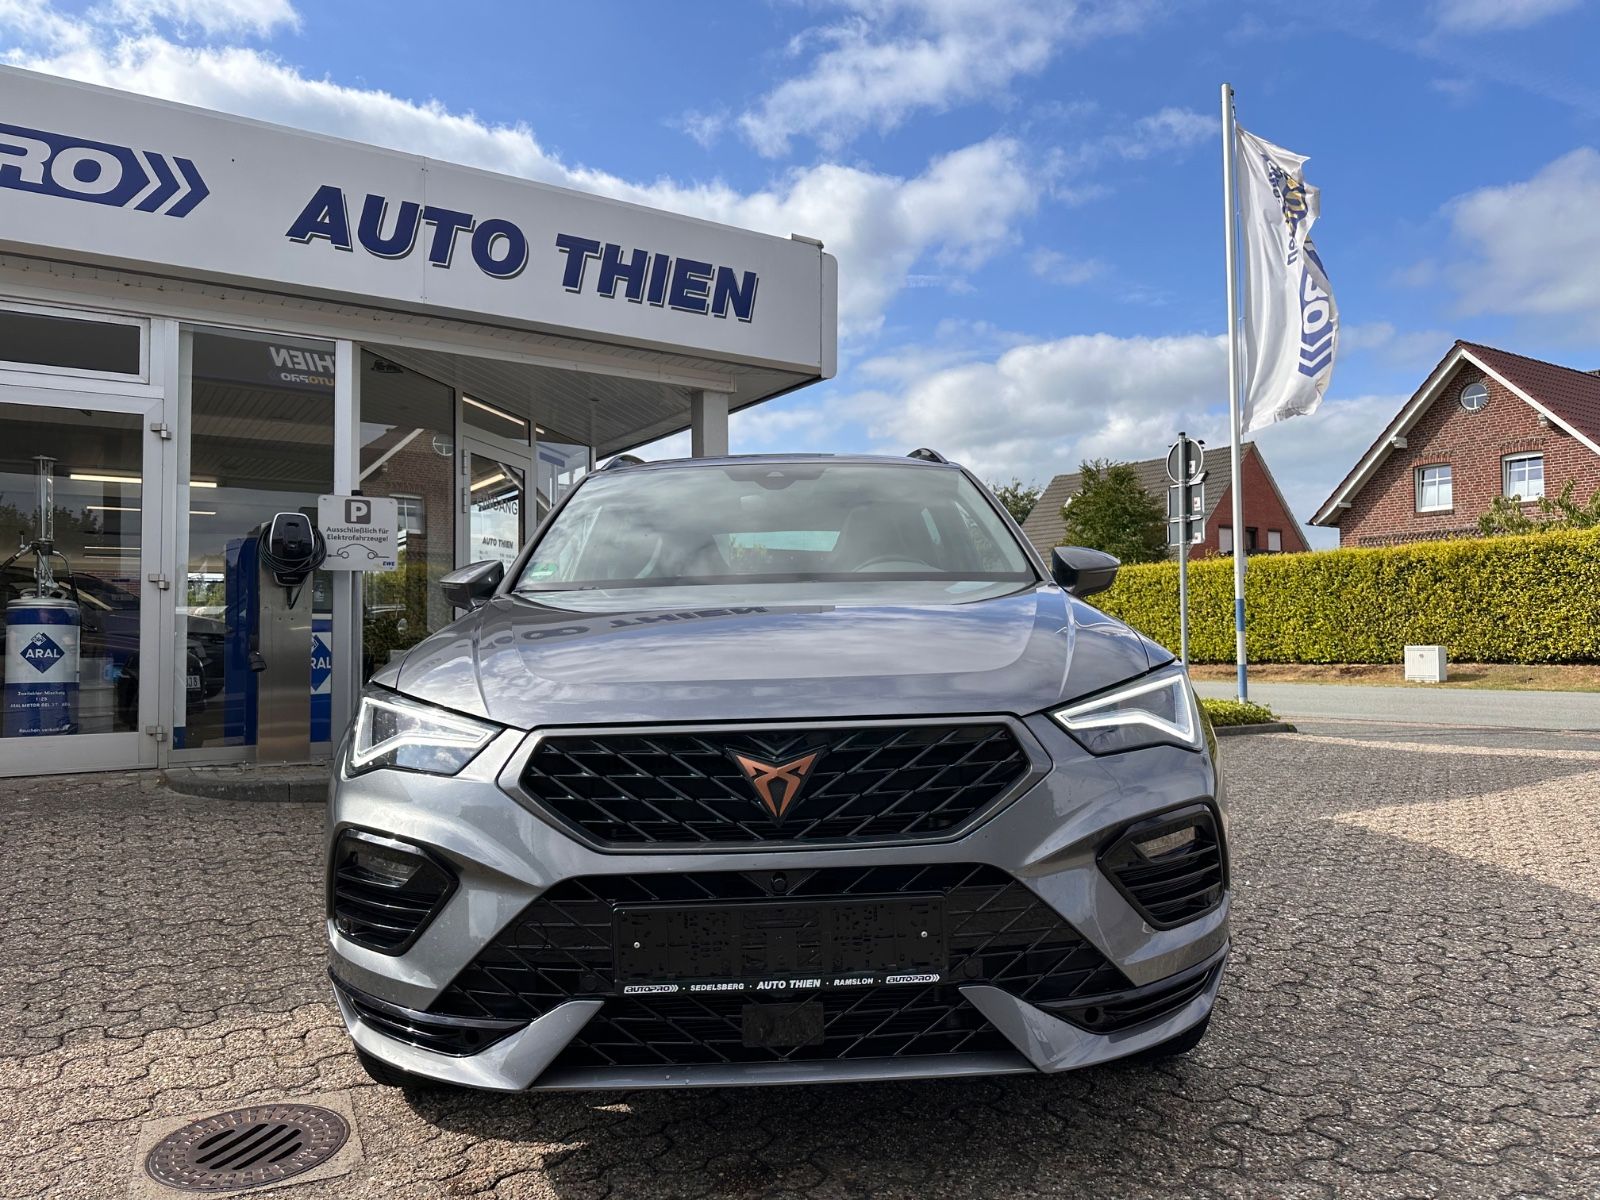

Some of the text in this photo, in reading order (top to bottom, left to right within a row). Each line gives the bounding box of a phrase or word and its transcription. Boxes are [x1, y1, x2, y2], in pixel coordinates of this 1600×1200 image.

[285, 185, 758, 323] AUTO THIEN
[350, 501, 368, 522] P
[326, 526, 389, 535] Ausschließlich für
[482, 536, 514, 549] AUTO THIEN
[25, 648, 60, 658] ARAL
[624, 974, 933, 994] AUTOPRO SEDELSBERG AUTO THIEN RAMSLOH AUTOPRO
